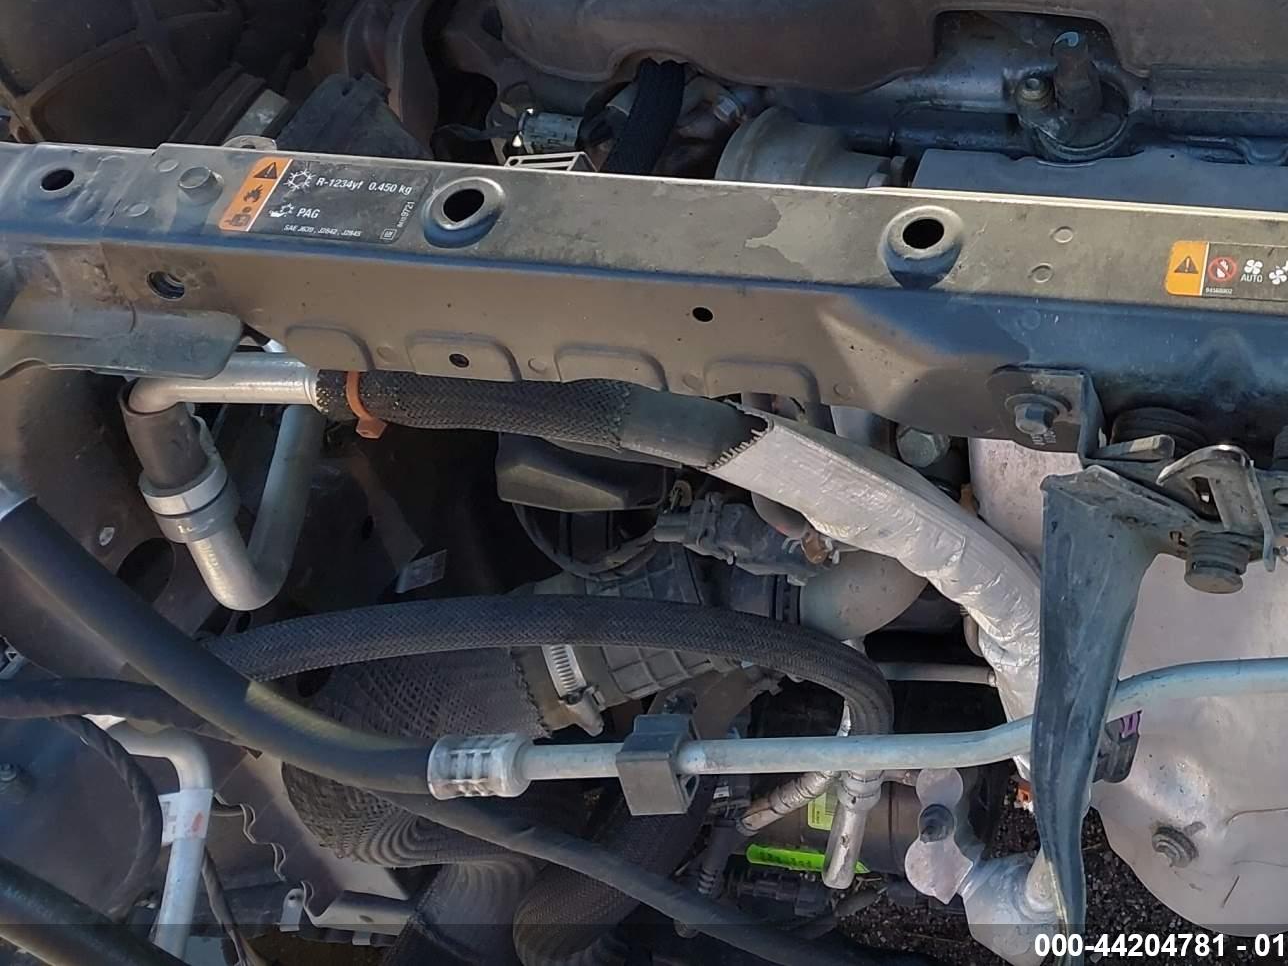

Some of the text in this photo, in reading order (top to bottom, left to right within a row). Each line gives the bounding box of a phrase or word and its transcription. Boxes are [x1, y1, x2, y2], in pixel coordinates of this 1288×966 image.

[315, 177, 413, 196] R-1234yf 0.450 kg
[296, 207, 321, 219] PAG
[283, 224, 298, 232] SAE
[1240, 273, 1263, 283] AUTO
